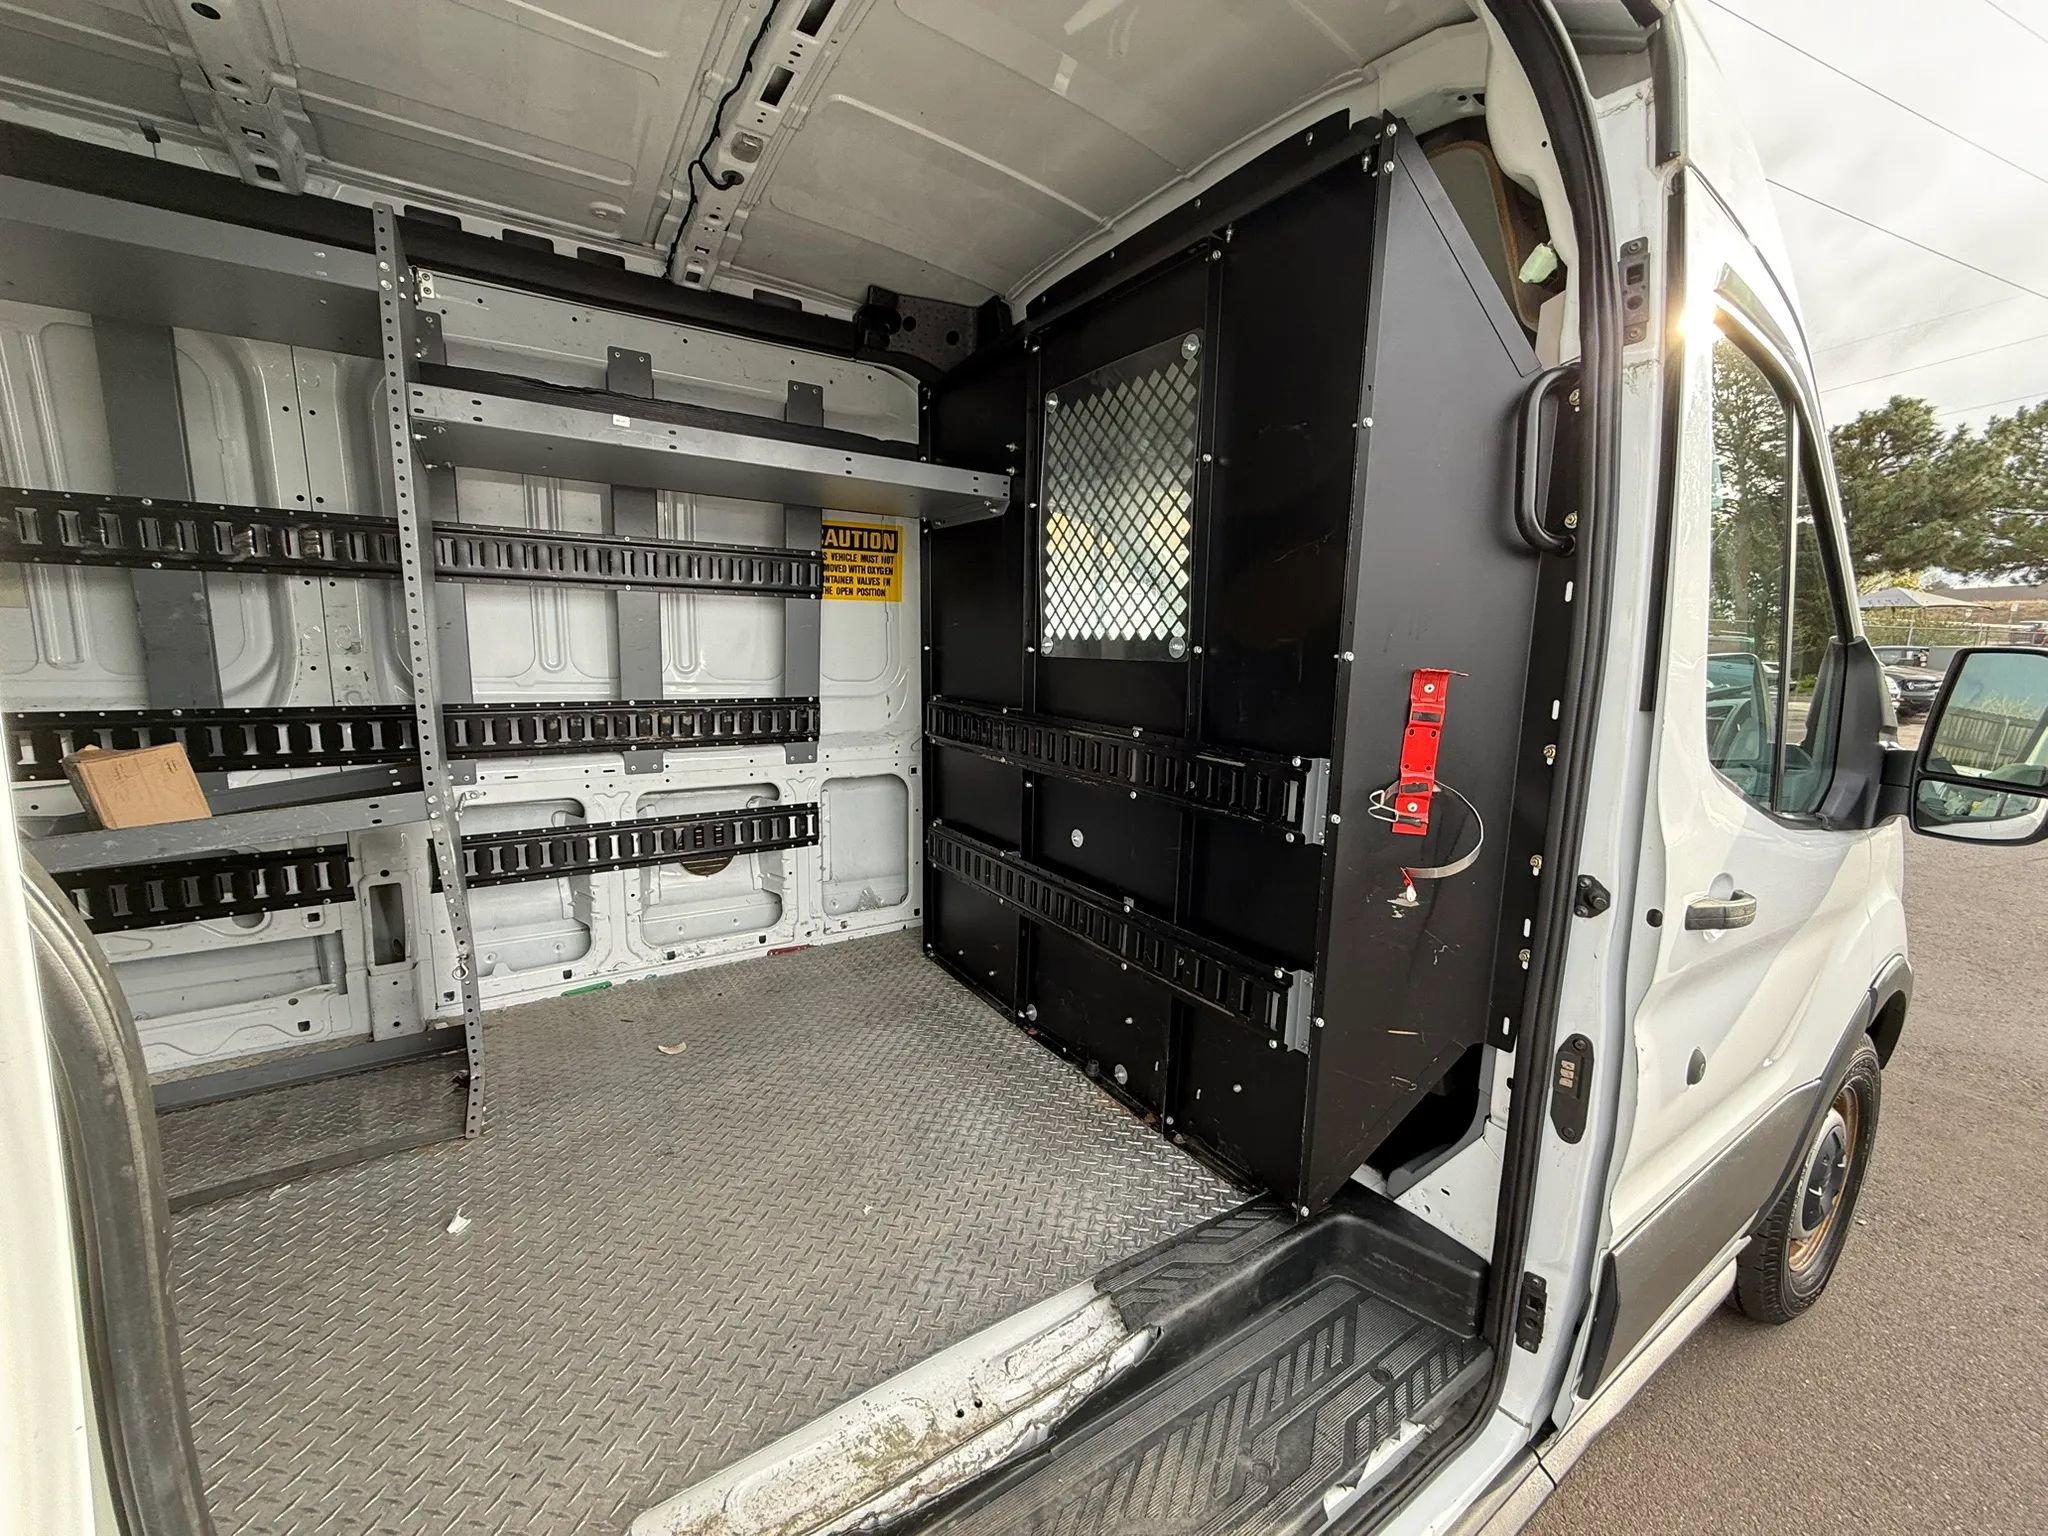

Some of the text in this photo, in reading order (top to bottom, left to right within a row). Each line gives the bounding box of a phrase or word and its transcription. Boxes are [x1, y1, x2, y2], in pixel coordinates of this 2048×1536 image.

[821, 528, 895, 550] AUTION
[831, 552, 858, 562] VEHICLE
[861, 554, 879, 563] MUST
[881, 556, 894, 565] NOT
[849, 565, 866, 575] WITH
[867, 566, 894, 576] OXYGEN
[823, 575, 891, 587] NTAINER VALVES IN
[836, 587, 853, 596] OPEN
[856, 588, 886, 597] POSITION
